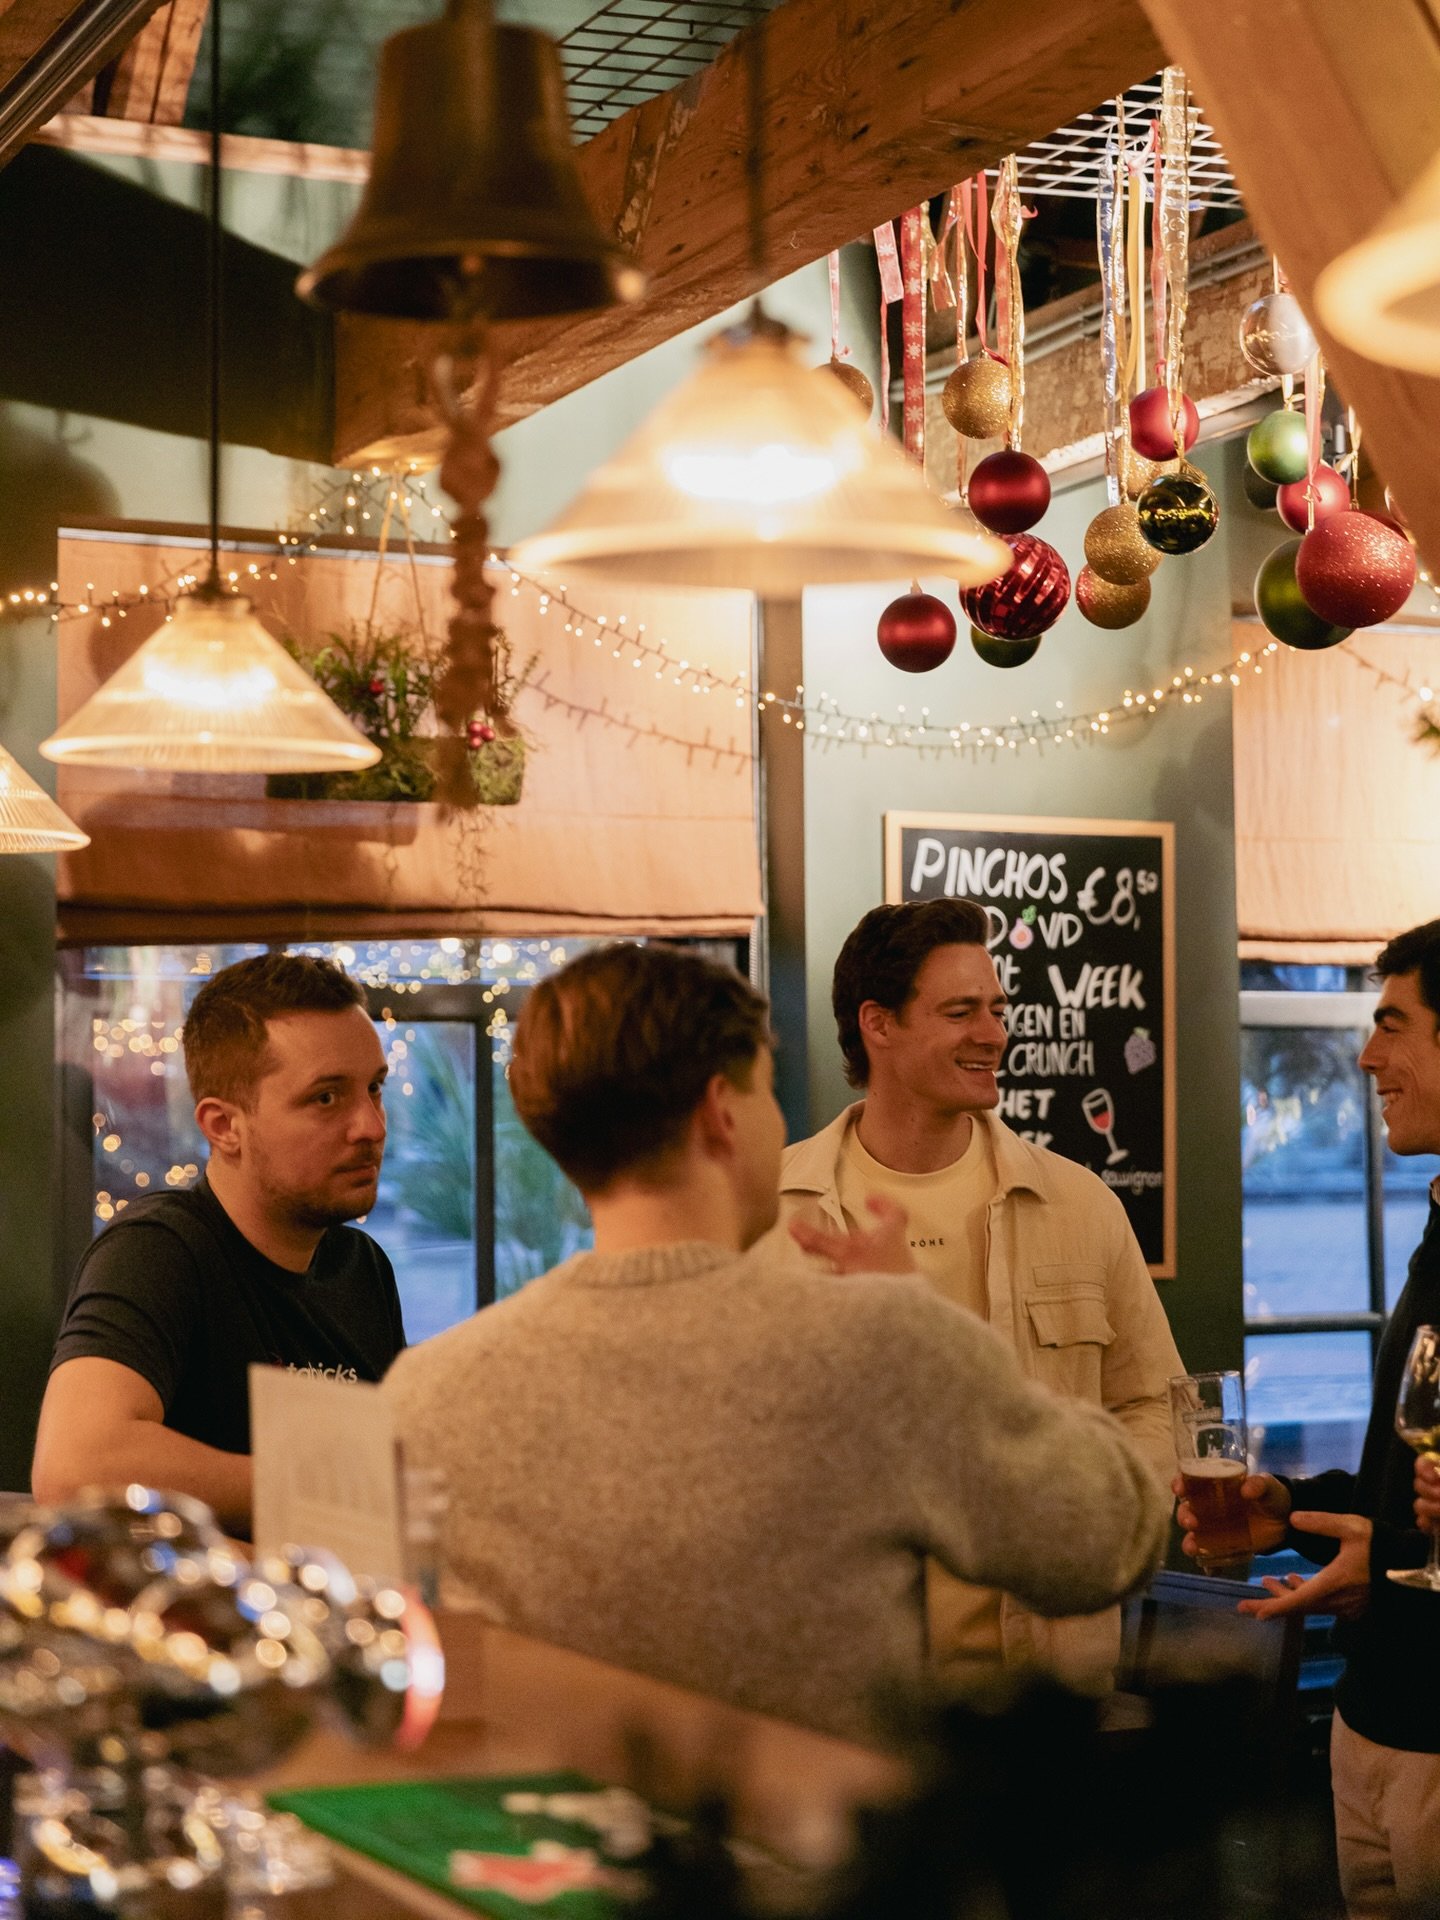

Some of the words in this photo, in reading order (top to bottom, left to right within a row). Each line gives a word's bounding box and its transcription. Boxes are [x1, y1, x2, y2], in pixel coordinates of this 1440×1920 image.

[910, 838, 1068, 904] PINCHOS
[1048, 962, 1146, 1011] WEEK
[1059, 1007, 1086, 1040] EN
[1008, 1040, 1095, 1077] CRUNCH
[998, 1087, 1056, 1121] HET
